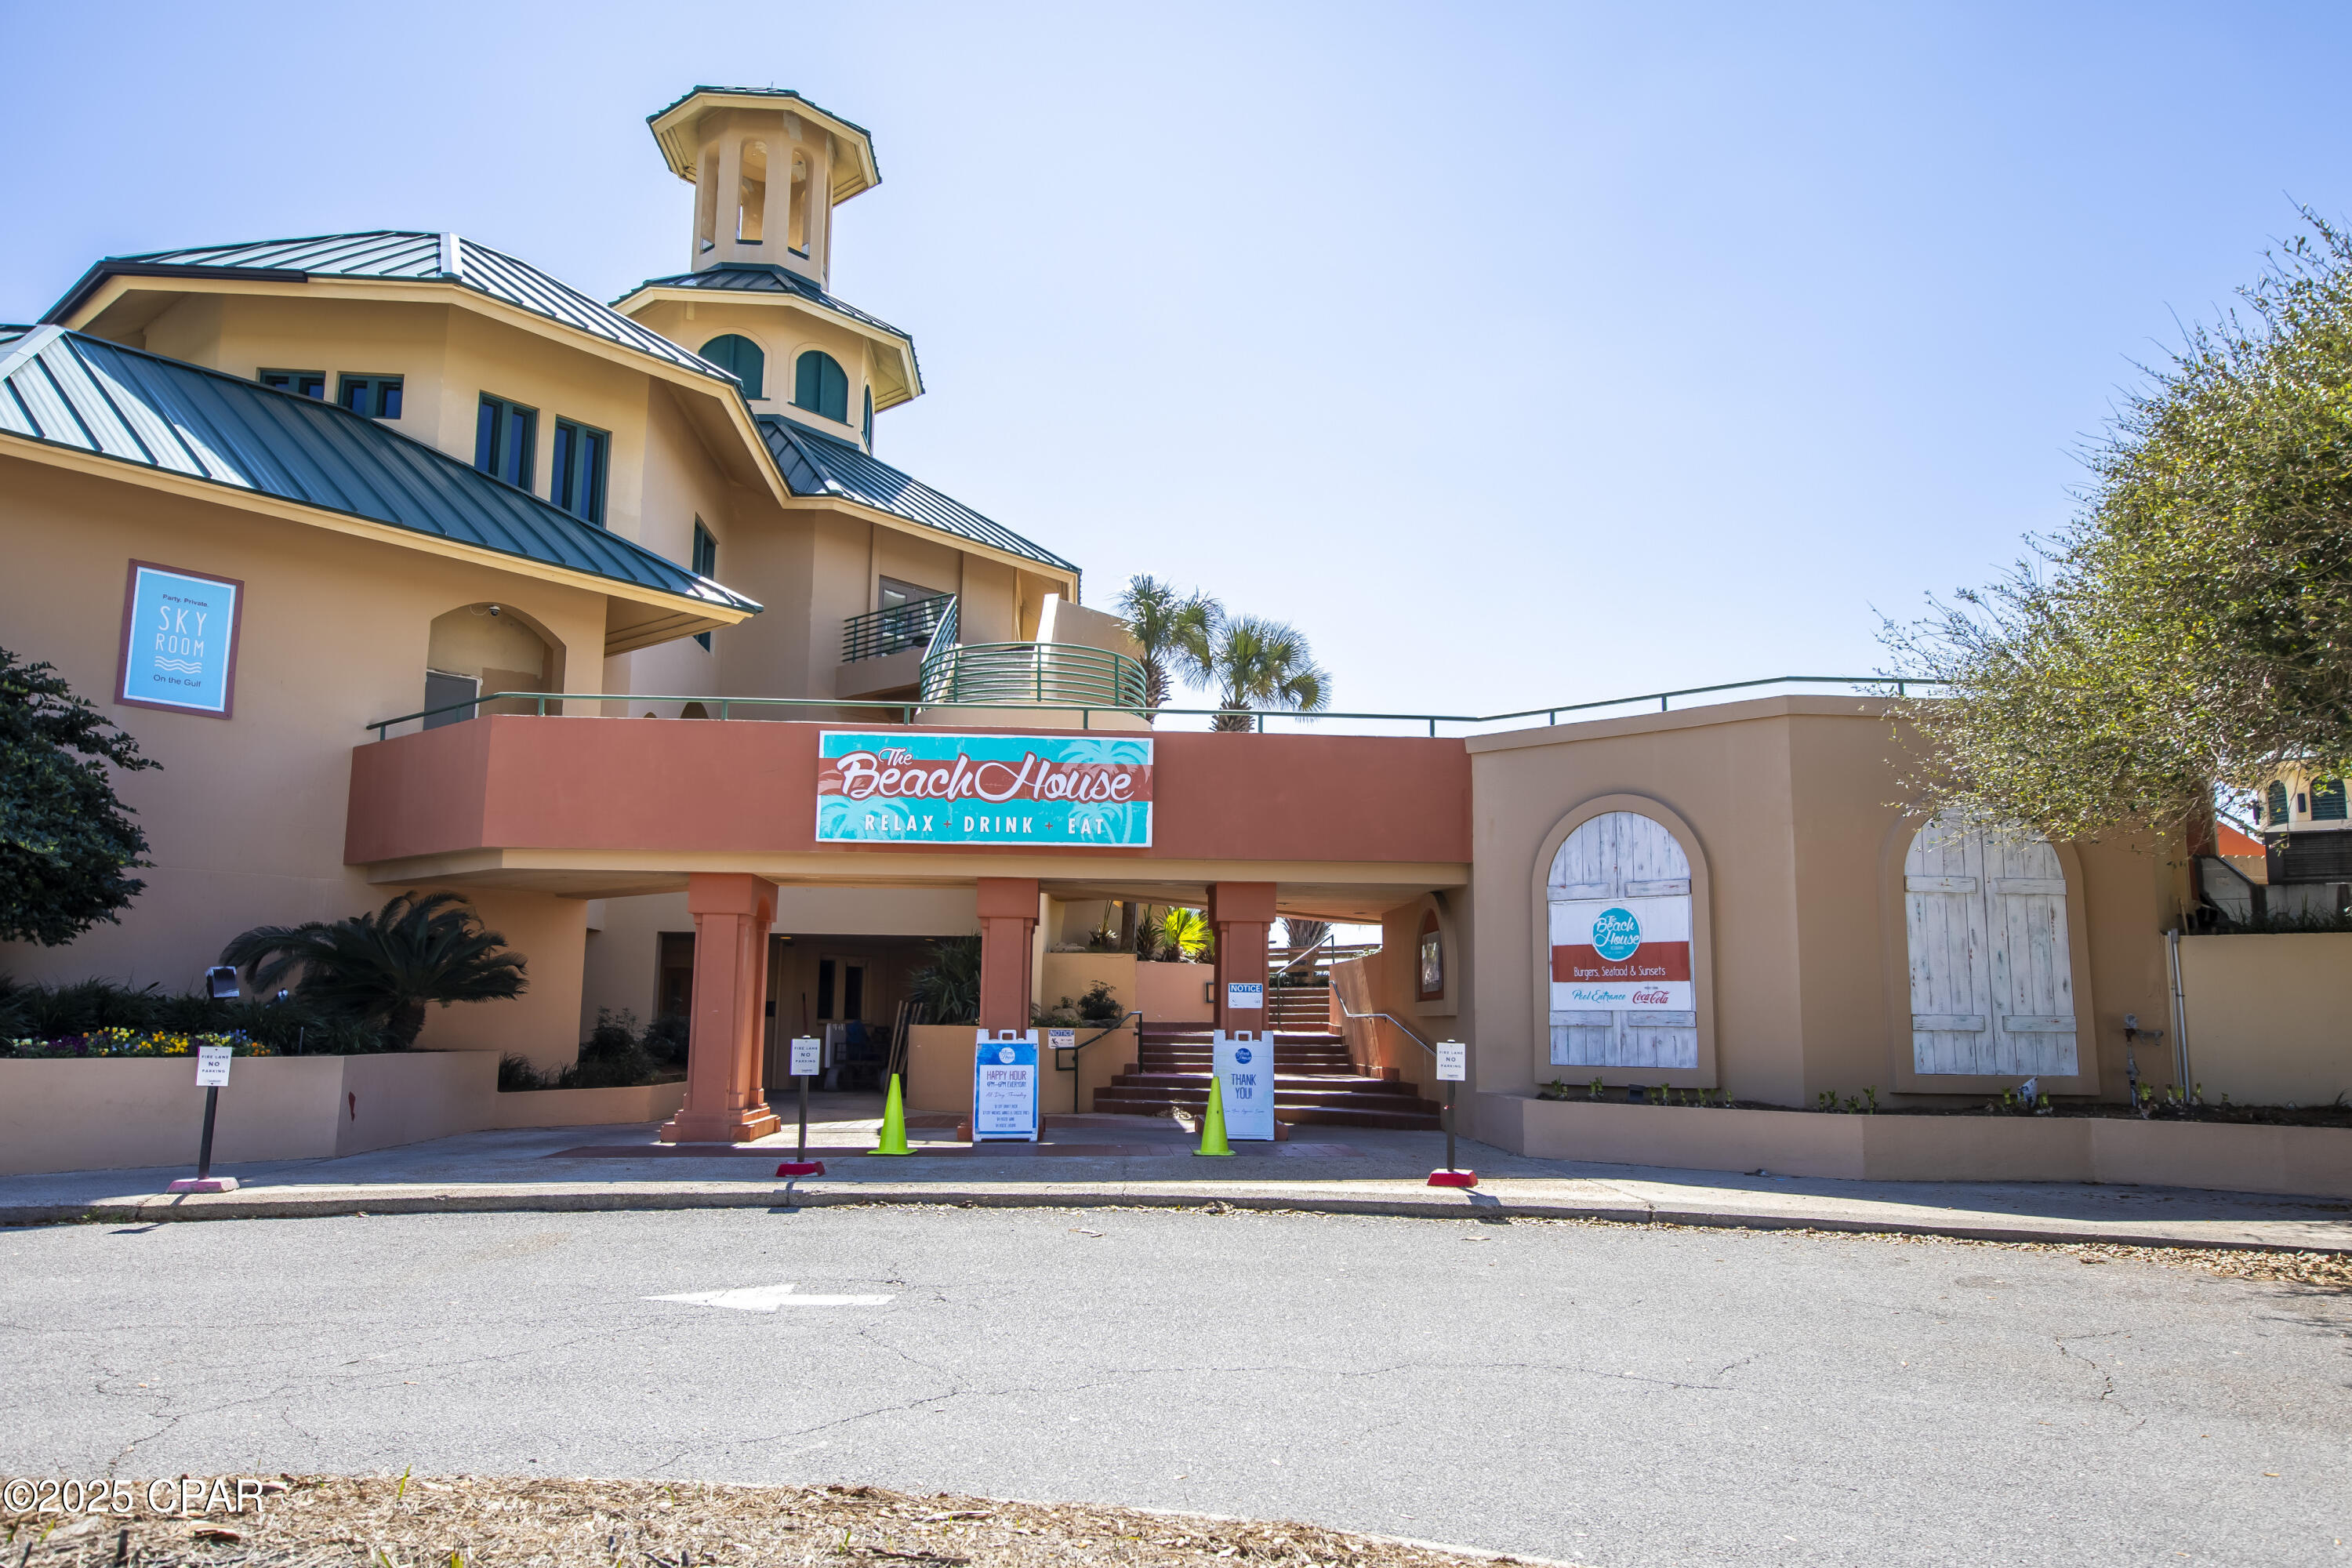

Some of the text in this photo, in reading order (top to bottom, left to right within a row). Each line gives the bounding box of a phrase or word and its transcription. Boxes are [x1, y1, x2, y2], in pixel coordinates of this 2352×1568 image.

[162, 593, 209, 608] Party. Private.
[158, 605, 208, 637] SKY
[155, 633, 205, 658] ROOM
[153, 674, 201, 688] On the Gulf
[878, 747, 913, 766] The
[837, 751, 1135, 802] Beach House
[865, 814, 935, 832] RELAX
[964, 816, 1033, 833] DRINK
[1068, 817, 1105, 835] EAT
[1595, 916, 1635, 933] Beach
[1594, 931, 1640, 947] House
[1573, 964, 1666, 980] Burgers, Seafood & Sunsets
[1592, 989, 1626, 1004] Entrance
[986, 1070, 1027, 1080] HAPPY HOUR
[1231, 1073, 1257, 1086] THANK
[1235, 1087, 1253, 1099] YOU!
